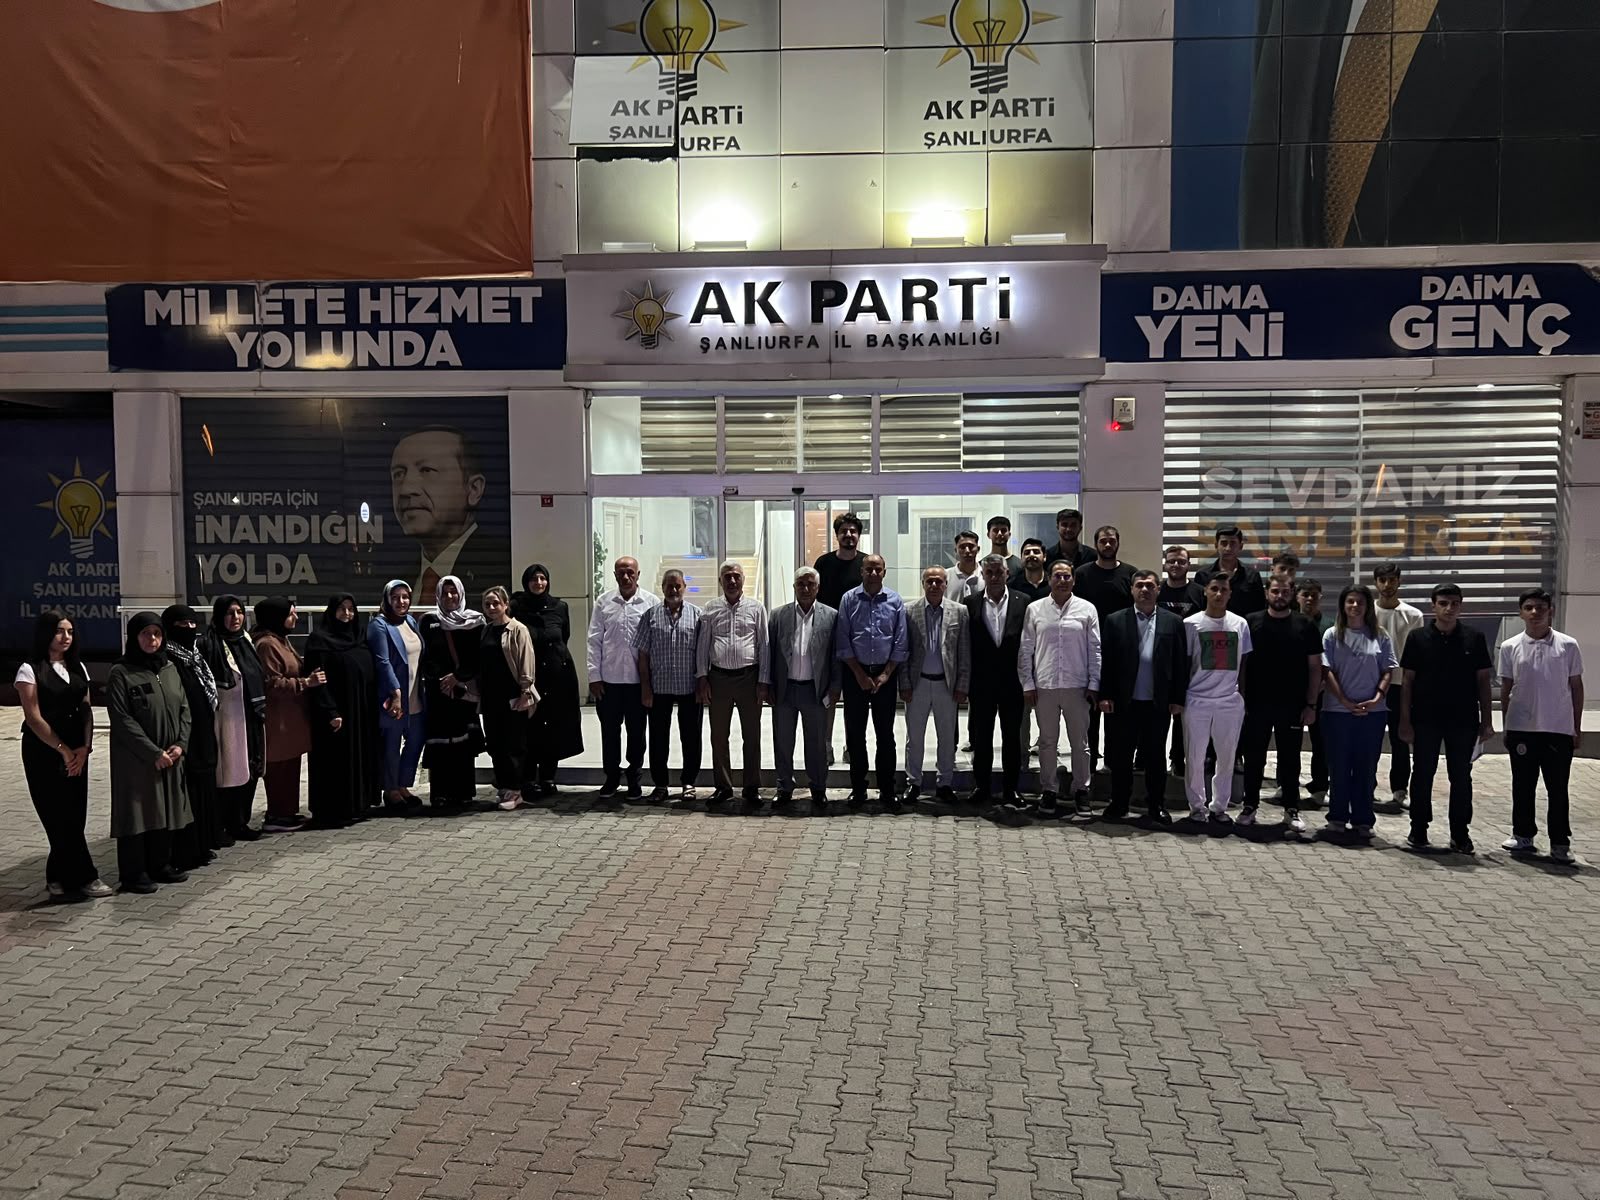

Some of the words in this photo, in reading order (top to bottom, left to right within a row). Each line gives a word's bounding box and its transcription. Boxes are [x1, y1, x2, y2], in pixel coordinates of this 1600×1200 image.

[610, 99, 651, 117] AK
[923, 100, 964, 120] AK
[923, 127, 1053, 149] ŞANLIURFA
[689, 280, 786, 326] AK
[700, 333, 820, 353] ŞANLIURFA
[834, 331, 852, 348] İL
[867, 327, 1000, 351] BAŞKANLIĞI
[1389, 303, 1572, 355] GENÇ
[224, 330, 462, 368] YOLUNDA
[1201, 464, 1520, 508] SEVDAMIZ
[193, 491, 283, 509] ŞANLIURFA
[287, 489, 318, 509] İÇİN
[48, 562, 72, 576] AK
[194, 553, 318, 584] YOLDA
[20, 600, 36, 617] İL
